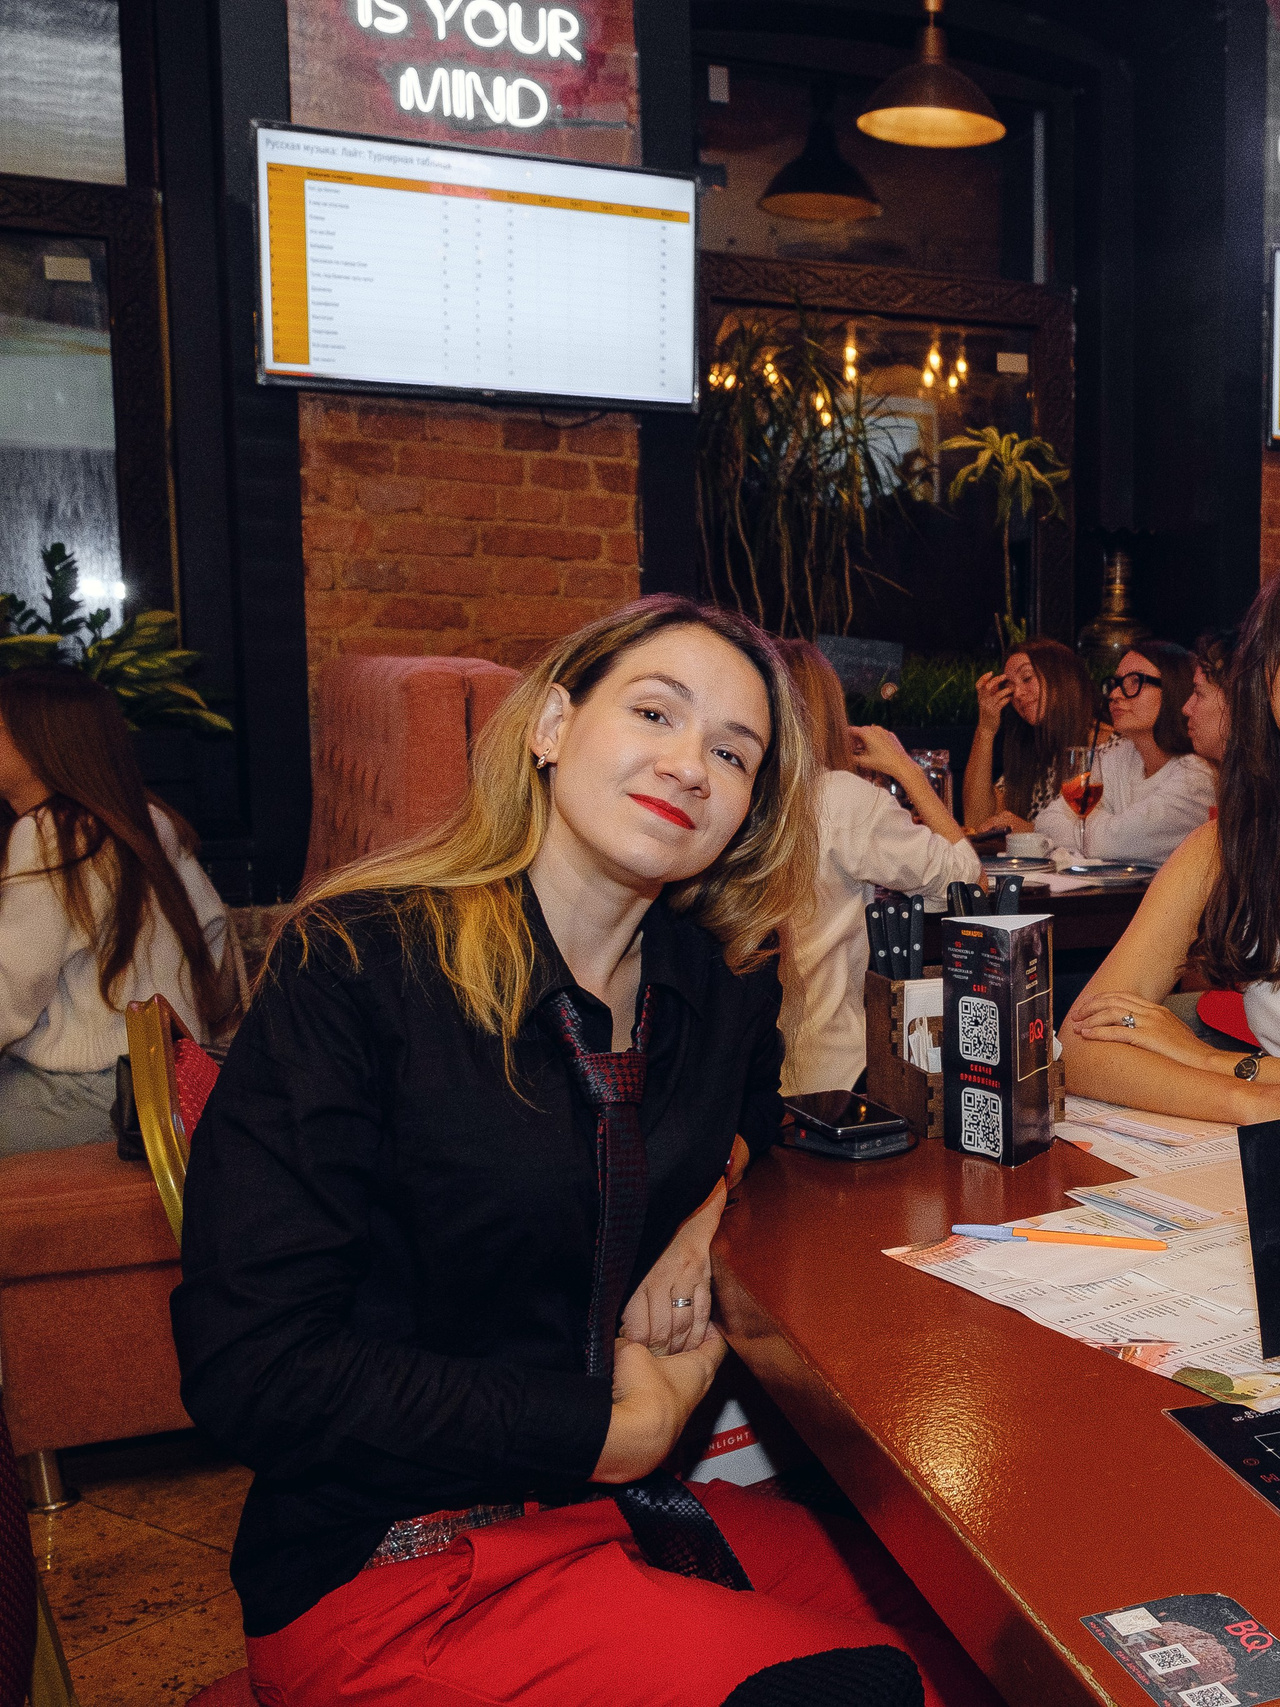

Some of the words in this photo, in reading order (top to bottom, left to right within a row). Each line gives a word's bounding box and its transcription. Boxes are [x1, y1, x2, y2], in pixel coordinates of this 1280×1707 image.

[357, 0, 408, 34] IS
[425, 0, 582, 61] YOUR
[400, 67, 549, 128] MIND
[1223, 1619, 1274, 1653] BQ
